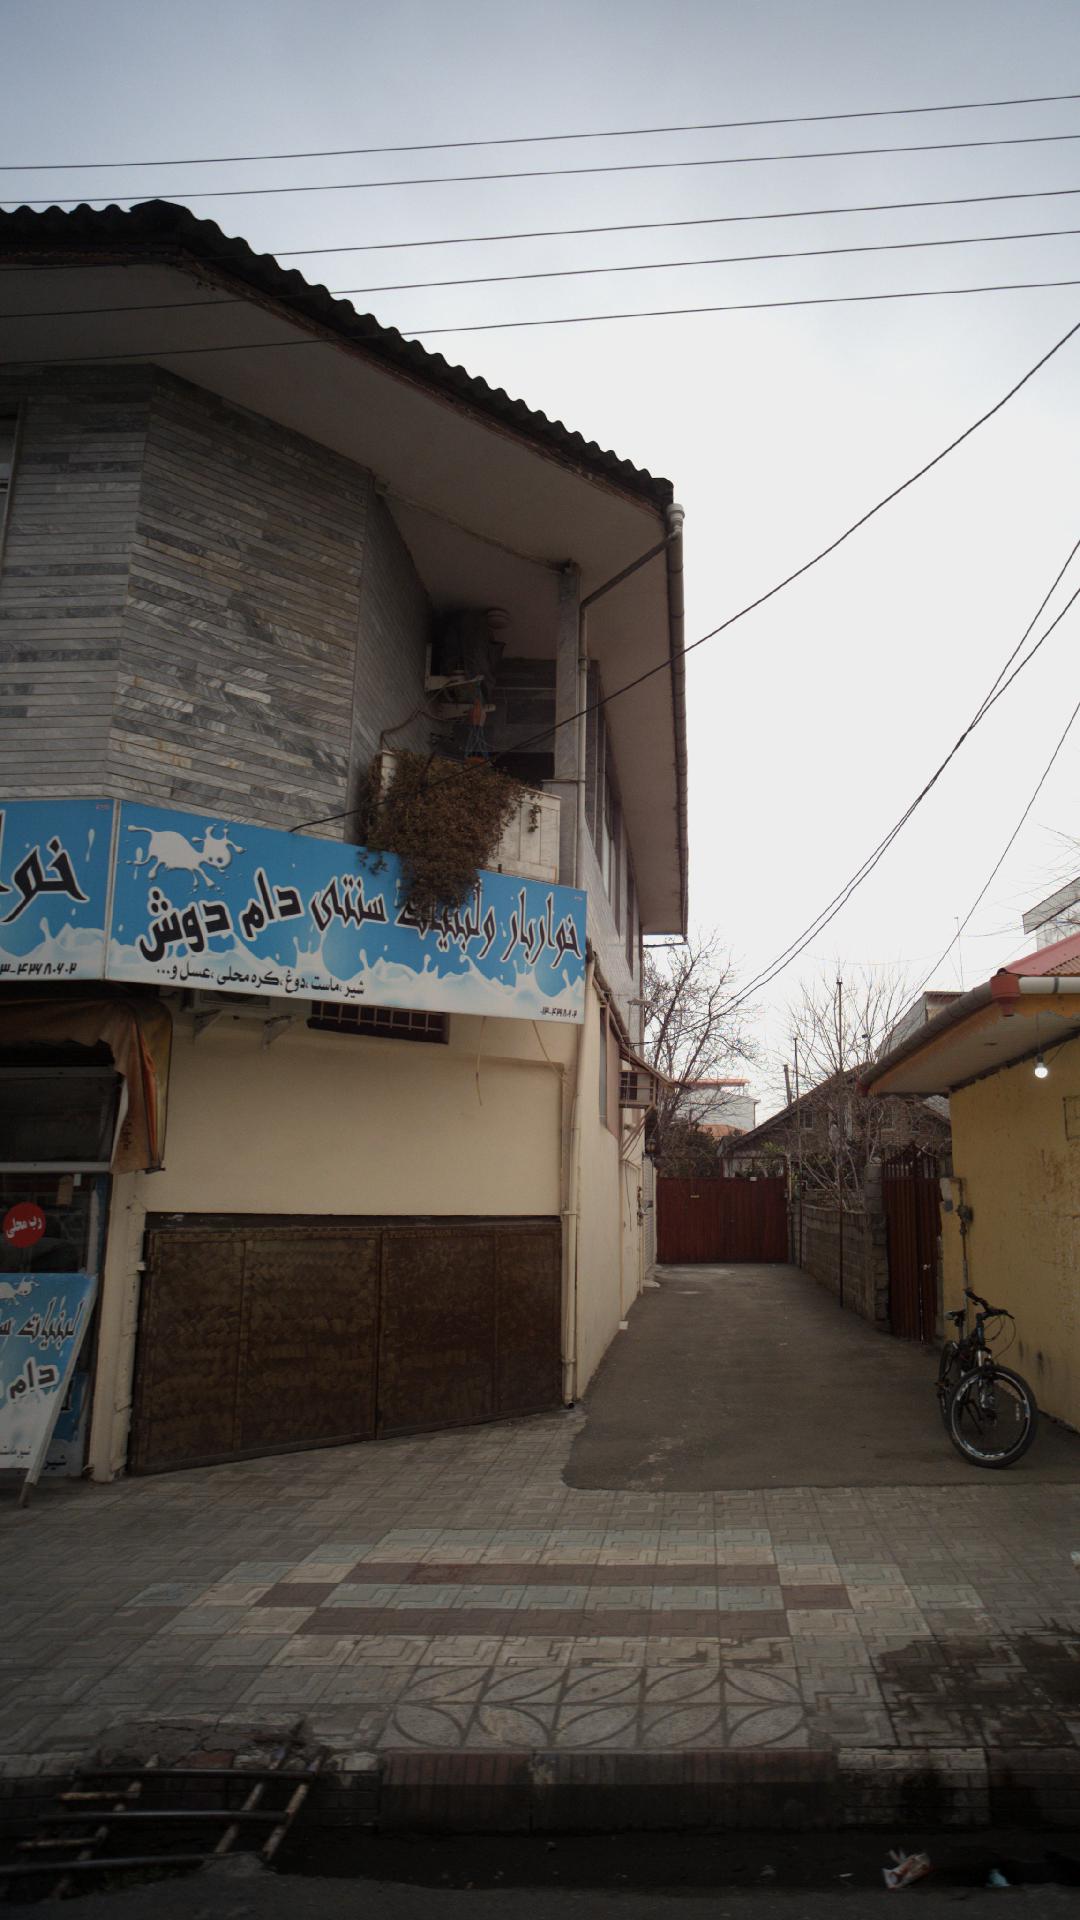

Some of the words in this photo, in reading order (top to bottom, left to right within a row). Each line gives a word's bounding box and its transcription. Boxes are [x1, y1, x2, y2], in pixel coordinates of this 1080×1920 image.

[137, 887, 232, 962] دوش
[240, 868, 303, 941] دام
[310, 873, 388, 932] سنتی
[501, 888, 582, 968] خواربار
[217, 966, 249, 985] محلی
[344, 981, 364, 998] شیر
[6, 1216, 28, 1239] محلی
[29, 1215, 42, 1231] رب
[17, 1297, 85, 1348] لبنیات
[9, 1356, 58, 1400] دام
[43, 1454, 67, 1472] شیر
